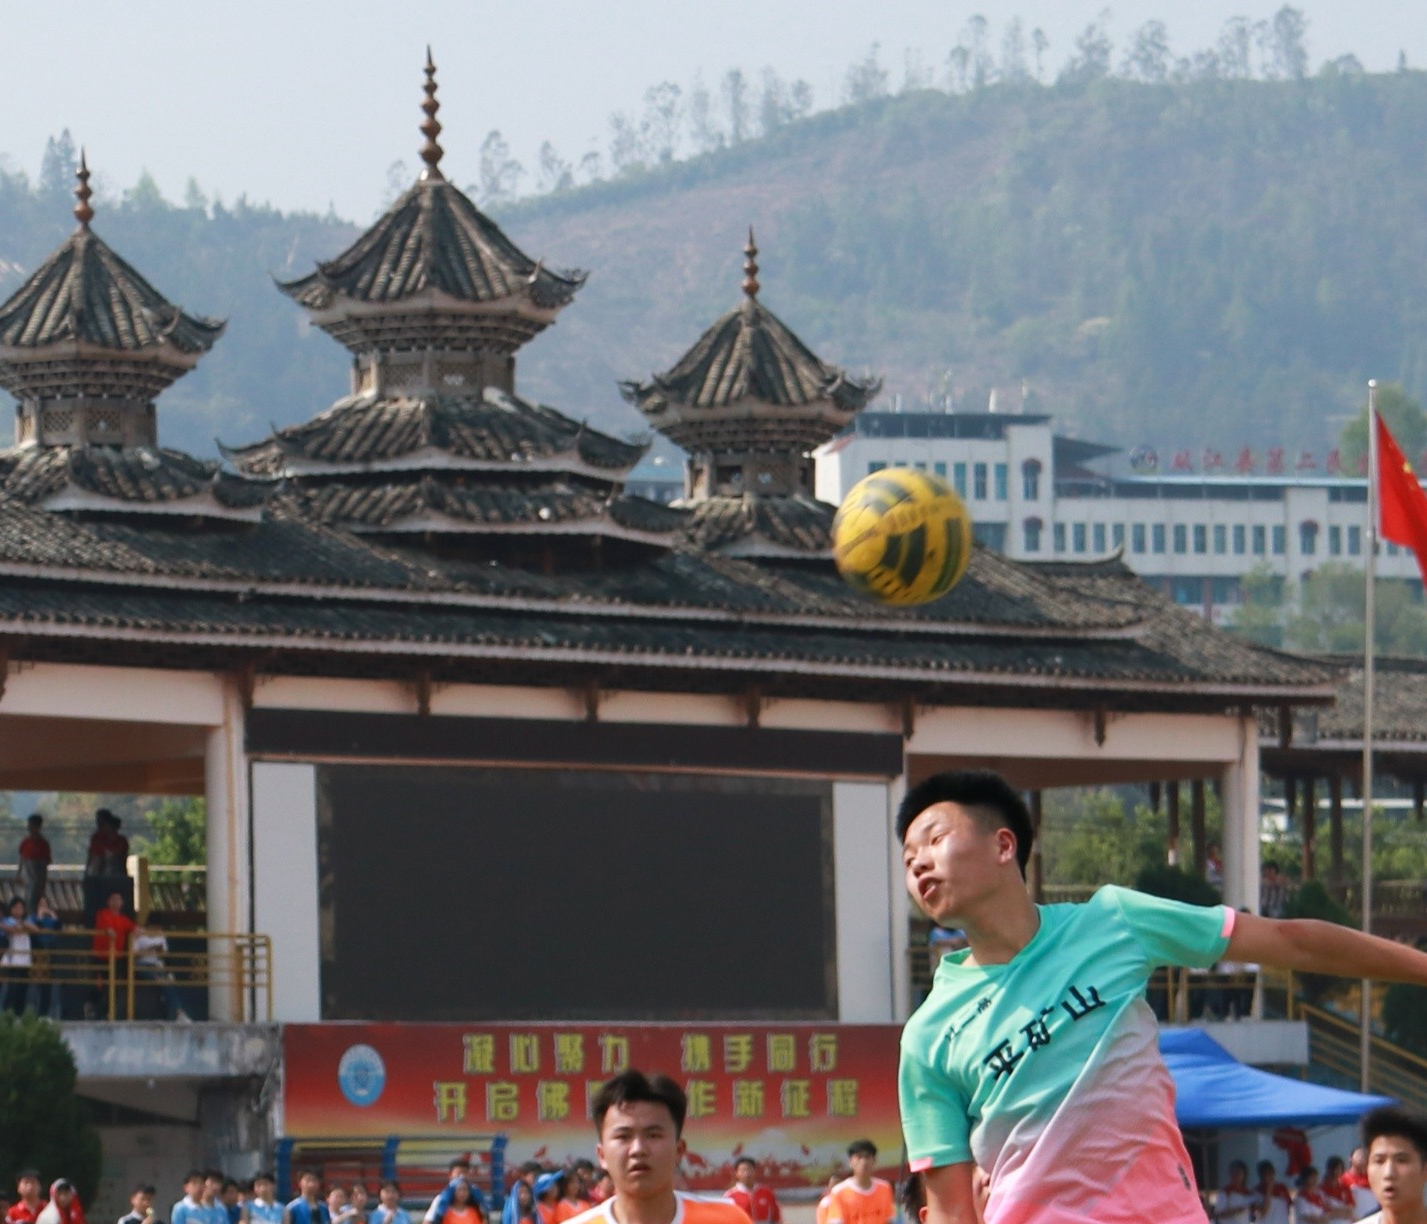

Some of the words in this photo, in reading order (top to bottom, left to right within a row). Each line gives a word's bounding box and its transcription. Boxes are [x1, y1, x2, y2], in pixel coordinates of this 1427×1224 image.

[463, 1033, 630, 1073] 凝心聚力
[681, 1033, 838, 1073] 携手同行
[983, 984, 1106, 1081] 平矿山
[434, 1079, 859, 1123] 开启佛作新征程
